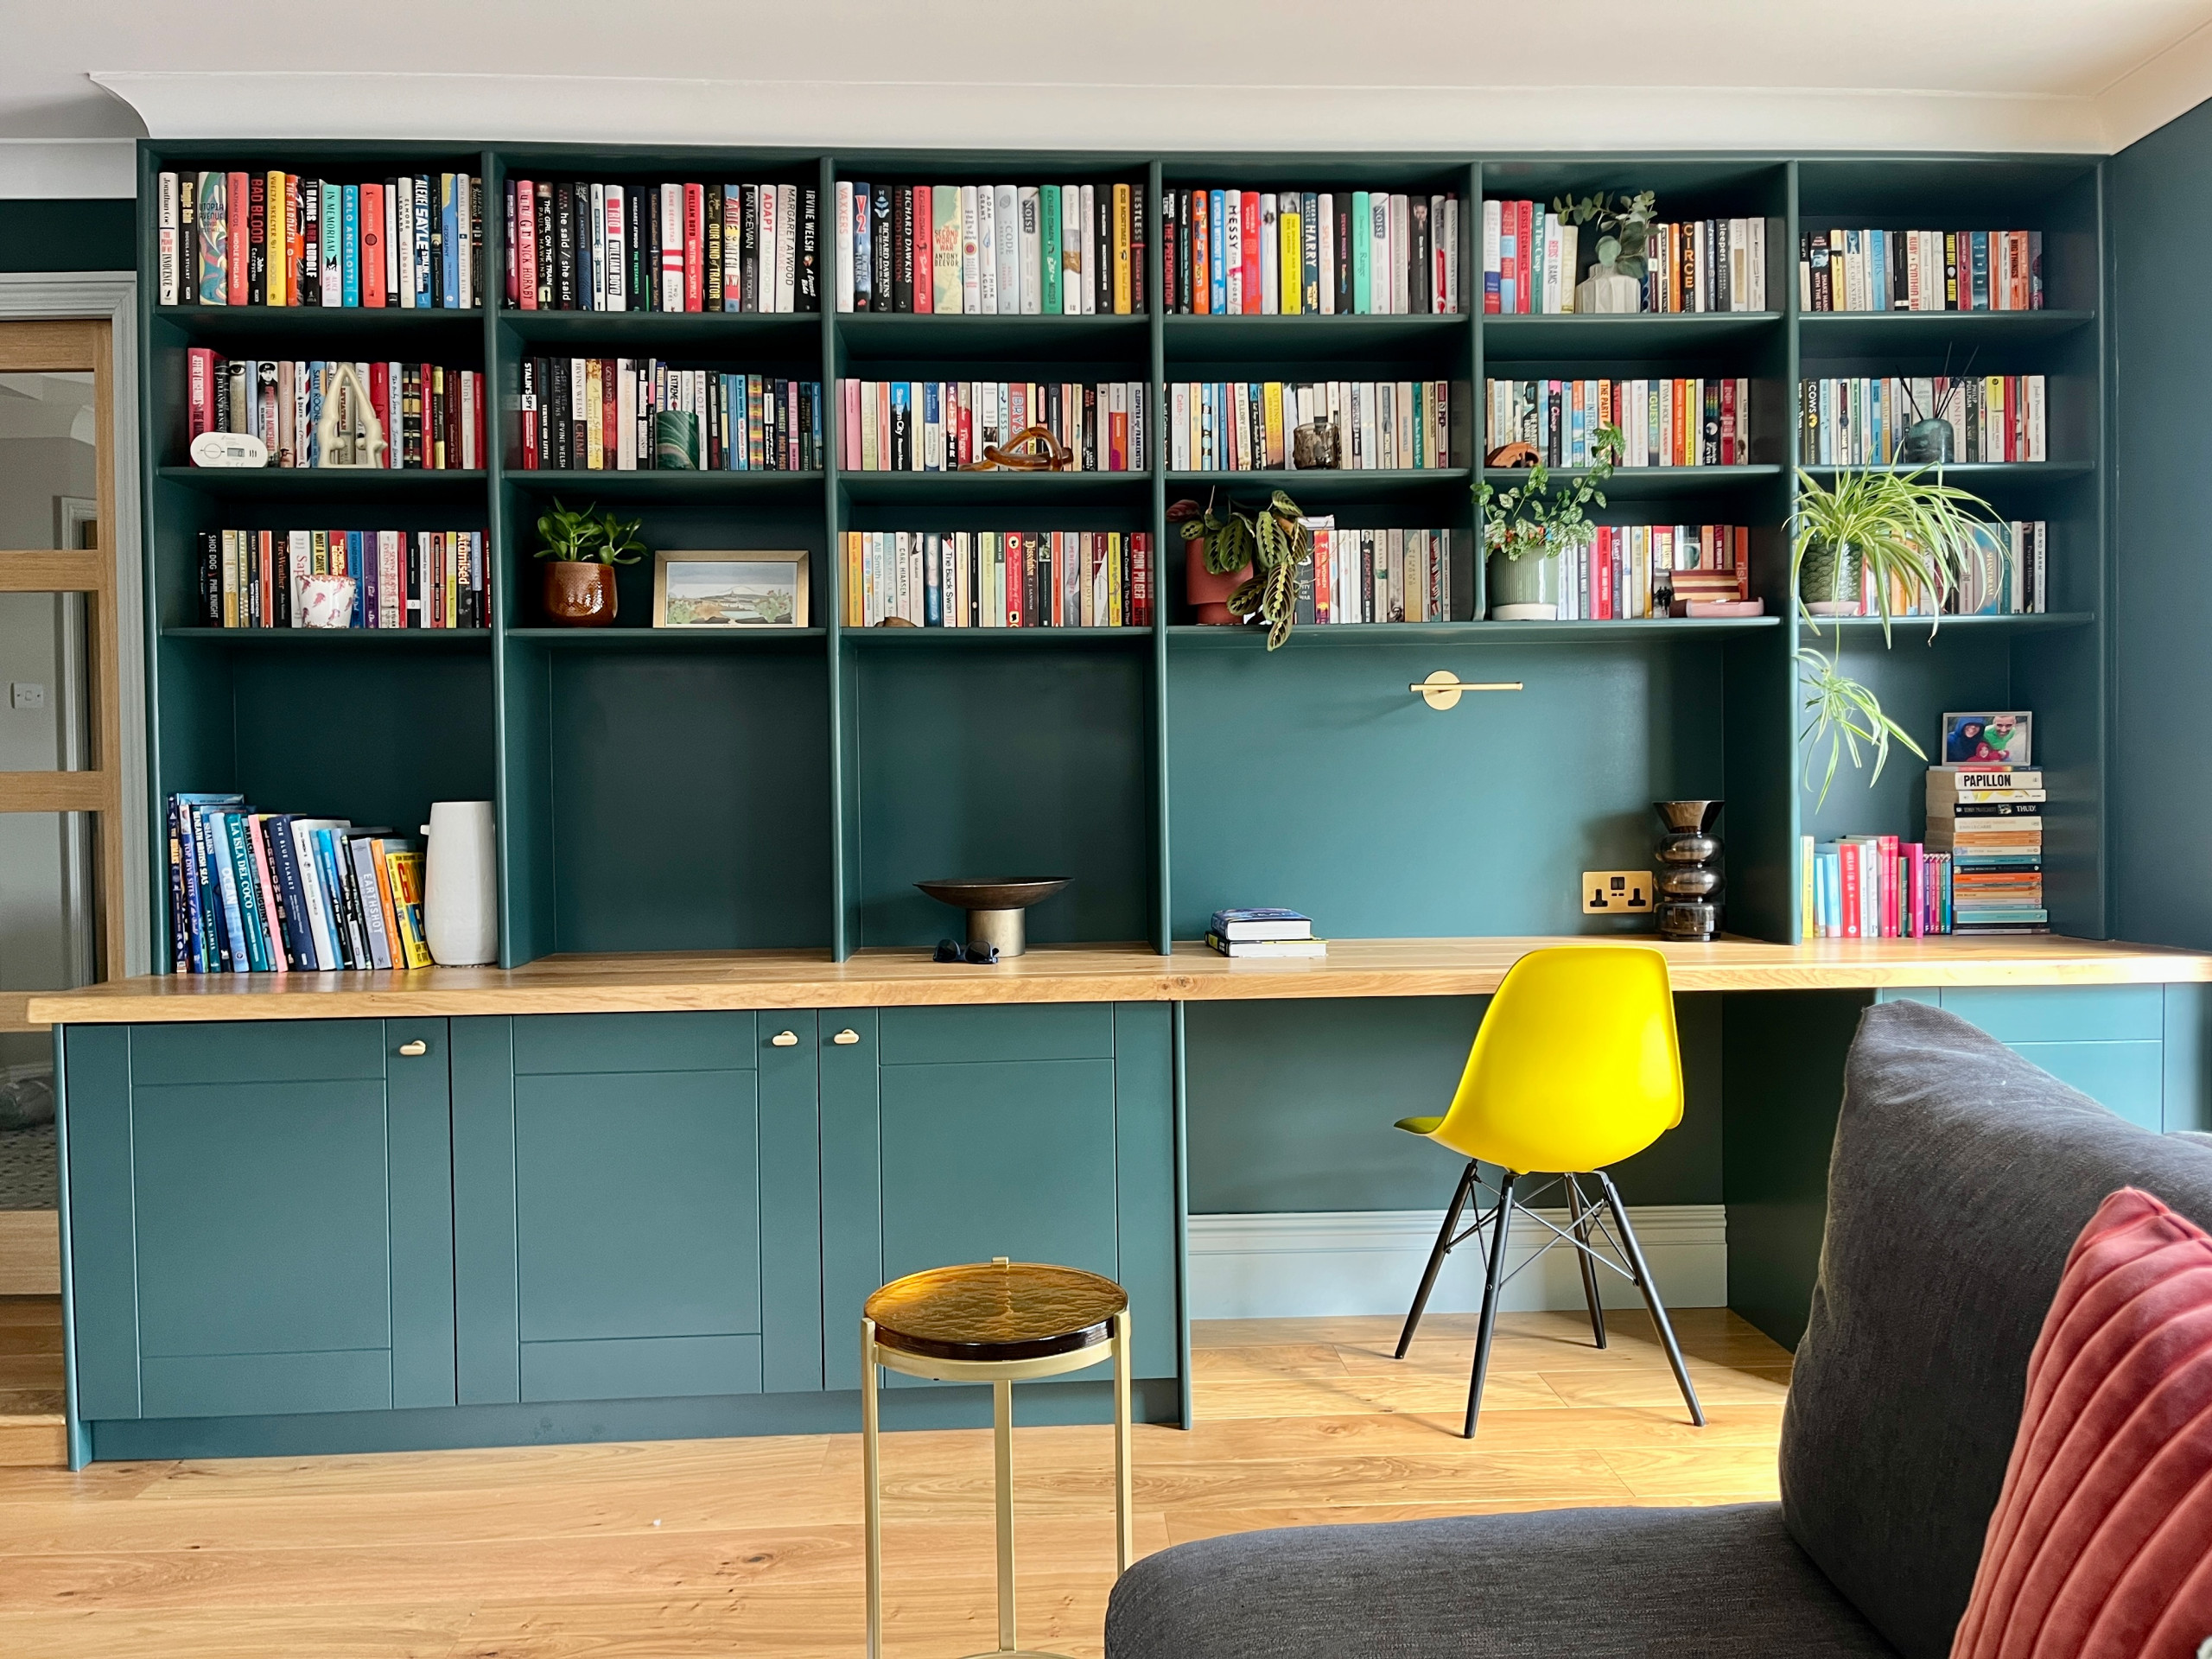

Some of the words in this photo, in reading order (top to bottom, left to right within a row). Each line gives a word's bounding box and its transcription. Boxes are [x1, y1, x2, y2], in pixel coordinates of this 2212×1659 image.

[181, 182, 193, 207] Shuggie
[251, 179, 263, 201] BAD
[327, 191, 334, 200] IN
[416, 180, 428, 206] ALEXEI
[520, 189, 532, 216] Funny
[182, 209, 193, 223] Bain
[608, 207, 620, 226] TRIO
[764, 194, 772, 232] ADAPT
[805, 190, 815, 219] IRVINE
[840, 188, 849, 234] VAXXERS
[251, 206, 263, 243] BLOOD
[327, 204, 335, 251] MEMORIAM
[416, 208, 429, 250] SAYLE
[520, 220, 532, 239] Girl
[561, 213, 569, 225] he
[709, 224, 720, 239] OUR
[1536, 212, 1542, 226] On
[546, 236, 551, 246] ON
[561, 228, 569, 248] said
[710, 241, 720, 258] KIND
[805, 223, 814, 251] WELSH
[1306, 225, 1316, 267] HARRY
[1719, 224, 1727, 262] sleepers
[522, 244, 531, 264] NICK
[609, 243, 620, 272] WILLIAM
[1357, 252, 1367, 276] Range
[1533, 248, 1544, 271] Cusp
[1684, 225, 1694, 288] CIRCE
[162, 254, 172, 286] INNOCENCE
[709, 268, 721, 299] TRAITOR
[1165, 243, 1173, 305] PREMONITION
[524, 268, 533, 300] HORNBY
[609, 274, 620, 294] BOYD
[575, 424, 584, 458] CRIME
[895, 421, 904, 435] City
[2038, 529, 2042, 537] DO
[458, 533, 469, 584] Atomised
[1023, 540, 1036, 575] Dissolution
[1134, 550, 1144, 569] JOHN
[1134, 572, 1145, 599] PILGER
[1737, 562, 1746, 584] risk
[1963, 774, 2011, 786] PAPILLON
[193, 811, 201, 841] BENEATH
[204, 823, 214, 855] SHARKS
[231, 823, 238, 836] LA
[196, 842, 206, 867] BRITISH
[233, 837, 242, 859] ISLA
[237, 861, 245, 880] DEL
[244, 826, 254, 854] MARCH
[255, 883, 267, 923] PENGUINS
[283, 862, 295, 890] PLANET
[221, 868, 237, 905] OCEAN
[241, 881, 253, 908] COCO
[364, 874, 382, 933] EARTHSHOT
